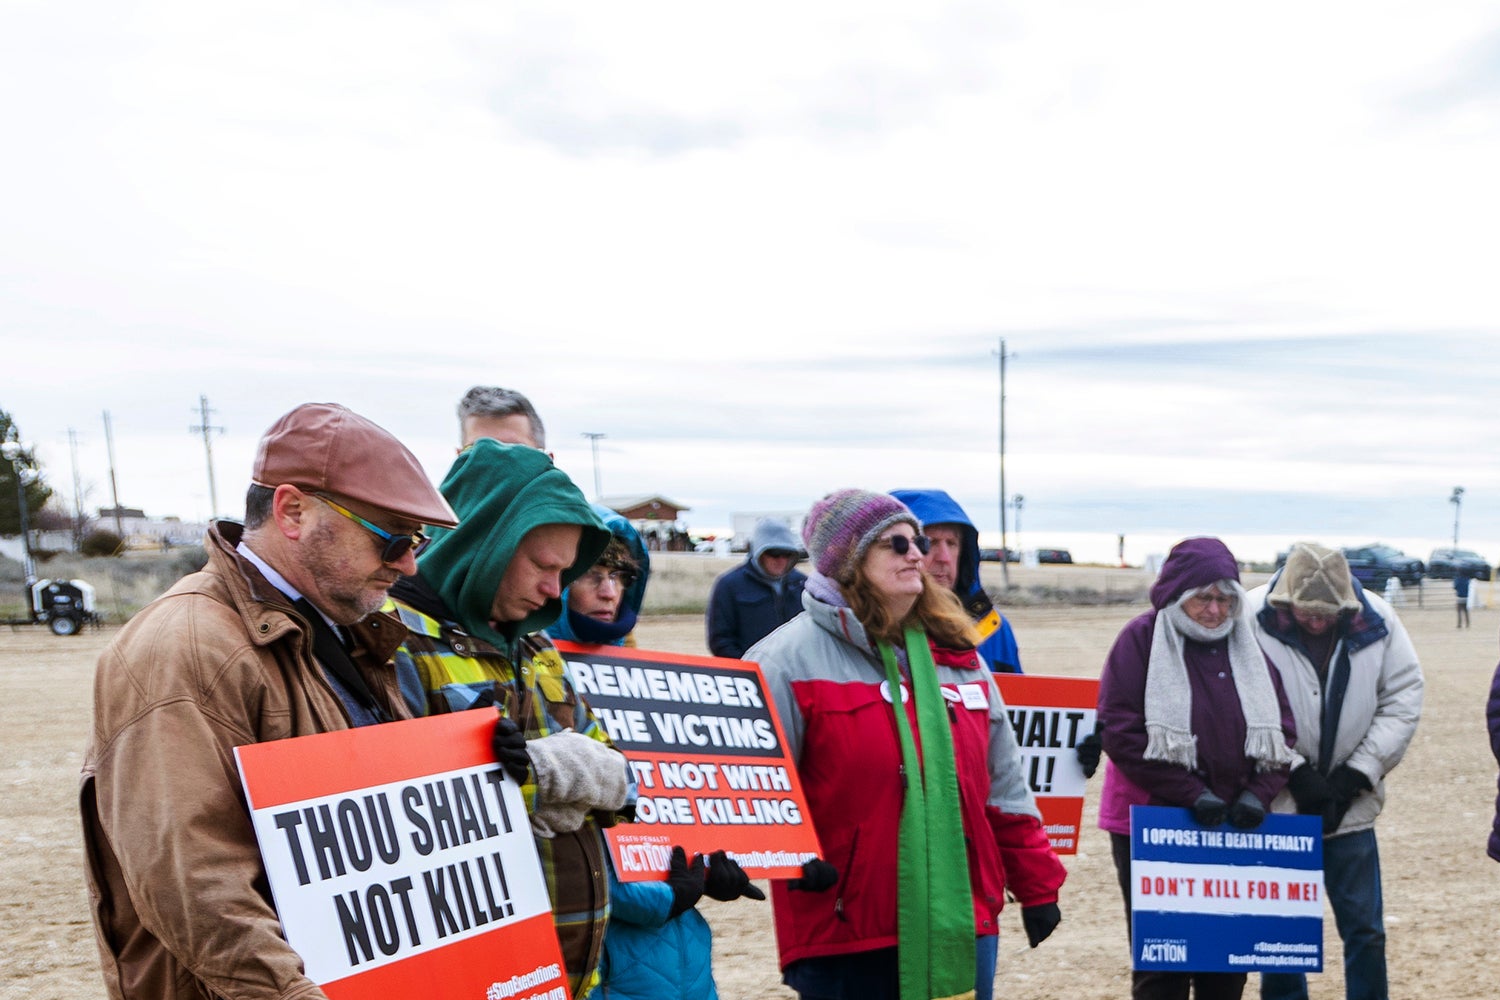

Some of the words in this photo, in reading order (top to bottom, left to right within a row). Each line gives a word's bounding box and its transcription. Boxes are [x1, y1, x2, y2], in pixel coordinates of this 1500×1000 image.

[567, 661, 764, 708] REMEMBER
[592, 708, 652, 742] HE
[650, 712, 777, 750] VICTIMS
[1007, 710, 1084, 748] HALT
[659, 761, 719, 790] NOT
[721, 764, 792, 791] WITH
[635, 797, 694, 824] ORE
[696, 798, 802, 825] KILLING
[273, 792, 400, 886] THOU
[402, 769, 514, 856] SHALT
[1143, 828, 1148, 844] I
[1150, 829, 1199, 847] OPPOSE
[1201, 832, 1223, 848] THE
[1225, 833, 1262, 850] DEATH
[1265, 836, 1314, 852] PENALTY
[618, 842, 674, 872] ACTION
[1141, 876, 1195, 896] DON'T
[1203, 879, 1240, 898] KILL
[1248, 881, 1279, 900] FOR
[1287, 883, 1317, 901] ME!
[333, 875, 421, 967] NOT
[422, 851, 515, 940] KILL!
[1141, 943, 1187, 963] ACTION
